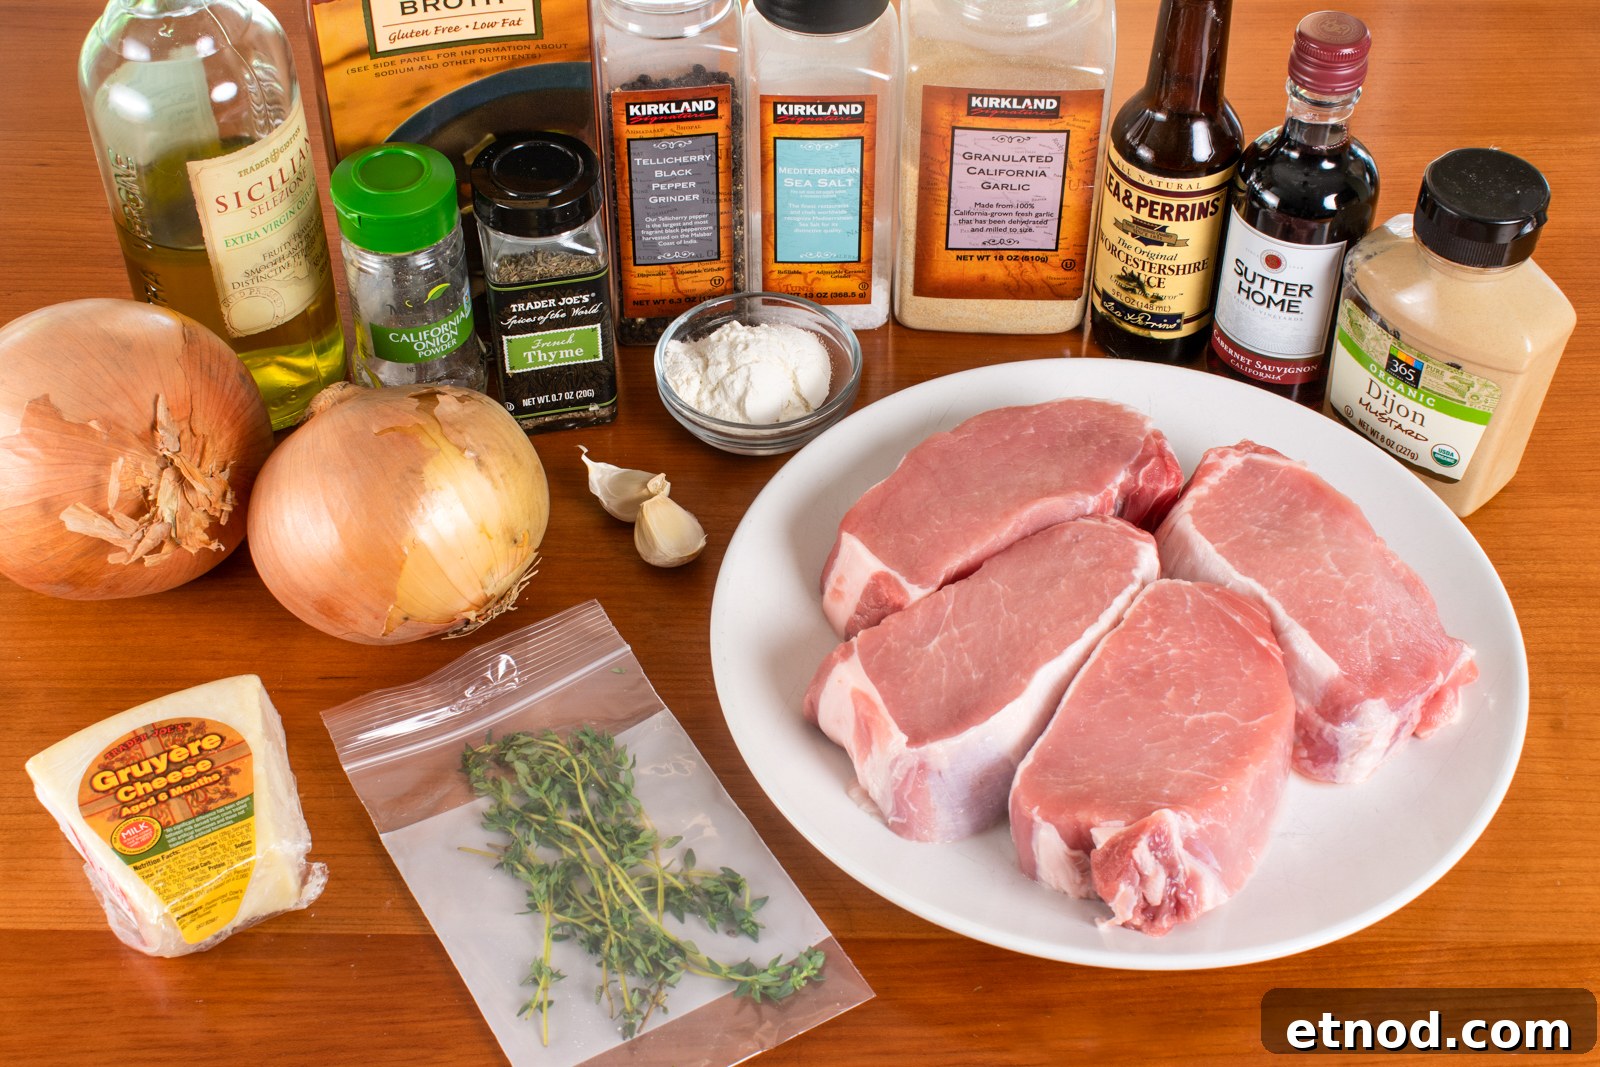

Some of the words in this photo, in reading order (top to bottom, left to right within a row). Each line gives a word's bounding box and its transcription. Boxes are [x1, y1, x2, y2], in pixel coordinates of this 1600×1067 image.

[388, 29, 431, 44] Gluten
[434, 25, 463, 35] Free
[472, 19, 499, 30] Low
[502, 17, 524, 28] Fat
[346, 65, 369, 75] (SEE
[373, 60, 396, 69] SIDE
[400, 55, 432, 64] PANEL
[436, 51, 457, 59] FOR
[460, 44, 531, 56] INFORMATION
[534, 43, 568, 51] ABOUT
[374, 67, 414, 78] SODIUM
[418, 62, 439, 71] AND
[442, 58, 476, 67] OTHER
[629, 100, 716, 116] KIRKLAND
[776, 104, 863, 116] KIRKLAND
[971, 96, 1058, 110] KIRKLAND
[634, 154, 711, 166] TELLICHERRY
[962, 151, 1054, 163] GRANULATED
[238, 157, 270, 178] TRADER
[654, 169, 692, 178] BLACK
[778, 167, 860, 175] MEDITERRANEAN
[966, 166, 1047, 178] CALIFORNIA
[1114, 159, 1132, 178] ALL
[1138, 174, 1203, 190] NATURAL
[652, 182, 696, 191] PEPPER
[783, 178, 813, 187] SEA
[817, 178, 854, 187] SALT
[981, 181, 1031, 192] GARLIC
[249, 167, 307, 219] SELEZIONE
[649, 194, 700, 204] GRINDER
[953, 209, 1013, 218] California-grown
[1136, 194, 1221, 222] PERRINS
[224, 230, 261, 248] EXTRA
[262, 208, 296, 235] VIRGIN
[681, 226, 713, 234] peppercorn
[1117, 236, 1133, 251] The
[1134, 246, 1178, 262] Original
[1234, 258, 1314, 298] SUTTER
[510, 298, 556, 312] TRADER
[558, 294, 590, 306] JOE'S
[633, 298, 649, 306] NET
[1125, 296, 1136, 306] OZ
[1136, 300, 1154, 311] (148
[500, 315, 536, 329] Spices
[537, 310, 552, 325] of
[550, 308, 567, 319] the
[571, 302, 603, 317] World
[389, 311, 466, 342] CALIFORNIA
[413, 327, 458, 351] ONION
[418, 339, 457, 358] POWDER
[531, 333, 576, 349] French
[523, 347, 584, 364] Thyme
[1213, 329, 1253, 365] CABERNET
[1254, 361, 1318, 374] SAUVIGNON
[1230, 359, 1282, 380] CALIFORNIA
[1390, 360, 1416, 381] 365
[1369, 363, 1436, 407] ORGANIC
[522, 397, 536, 407] NET
[551, 393, 563, 402] 0.7
[564, 391, 575, 399] OZ
[576, 389, 595, 399] (20G)
[1366, 378, 1425, 428] Dijon
[1359, 418, 1369, 432] NET
[1370, 426, 1380, 439] WT
[1380, 434, 1385, 443] 8
[1385, 438, 1396, 449] OZ
[1396, 444, 1419, 461] (227g)
[1438, 447, 1454, 457] USDA
[104, 733, 147, 760] TRADER
[92, 734, 222, 792] Gruyère
[115, 760, 212, 803] Cheese
[120, 797, 157, 817] Aged
[157, 792, 168, 802] 6
[169, 773, 221, 798] Months
[121, 822, 149, 839] MILK
[133, 858, 160, 871] Nutrition
[162, 849, 181, 860] Facts:
